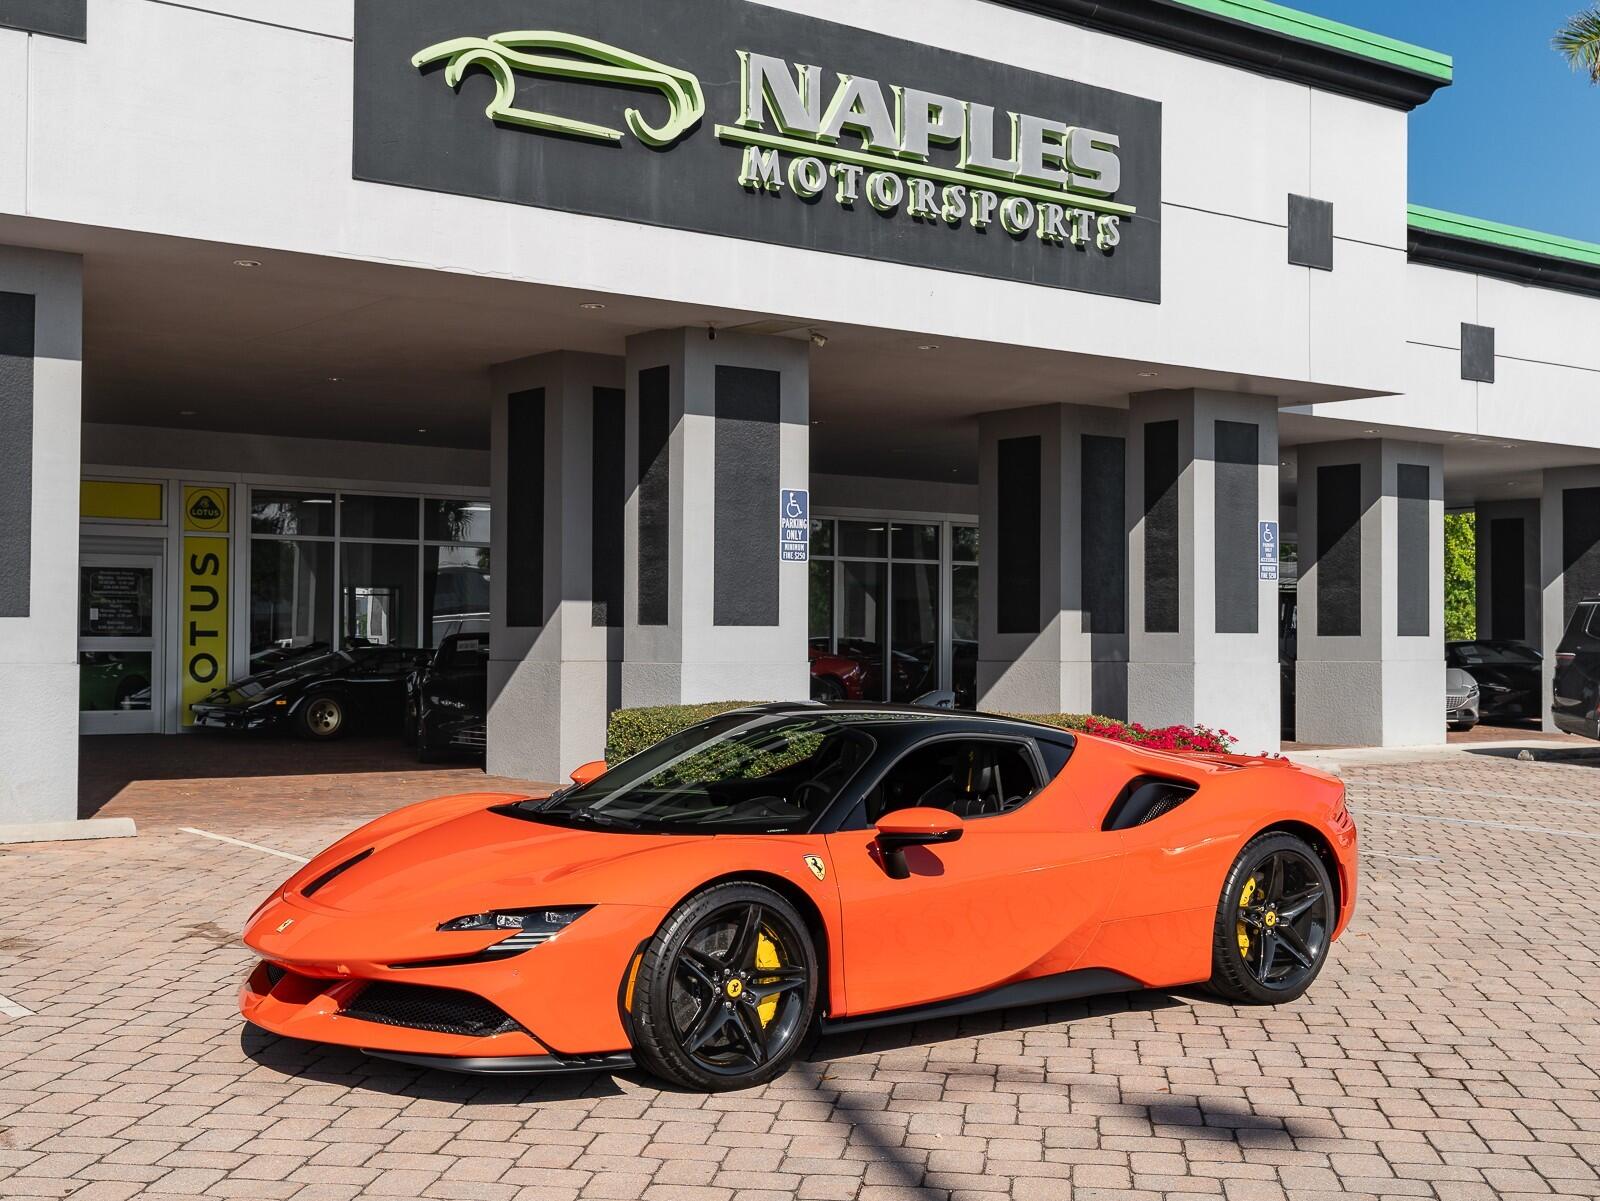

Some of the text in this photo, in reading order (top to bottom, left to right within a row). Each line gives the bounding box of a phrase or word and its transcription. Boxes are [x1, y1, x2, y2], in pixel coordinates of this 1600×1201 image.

[735, 50, 1120, 195] NAPLES
[738, 145, 1120, 250] MOTORSPORTS
[191, 508, 220, 517] LOTUS
[782, 518, 807, 529] PARKING
[787, 530, 802, 540] ONLY
[189, 552, 220, 711] OTUS
